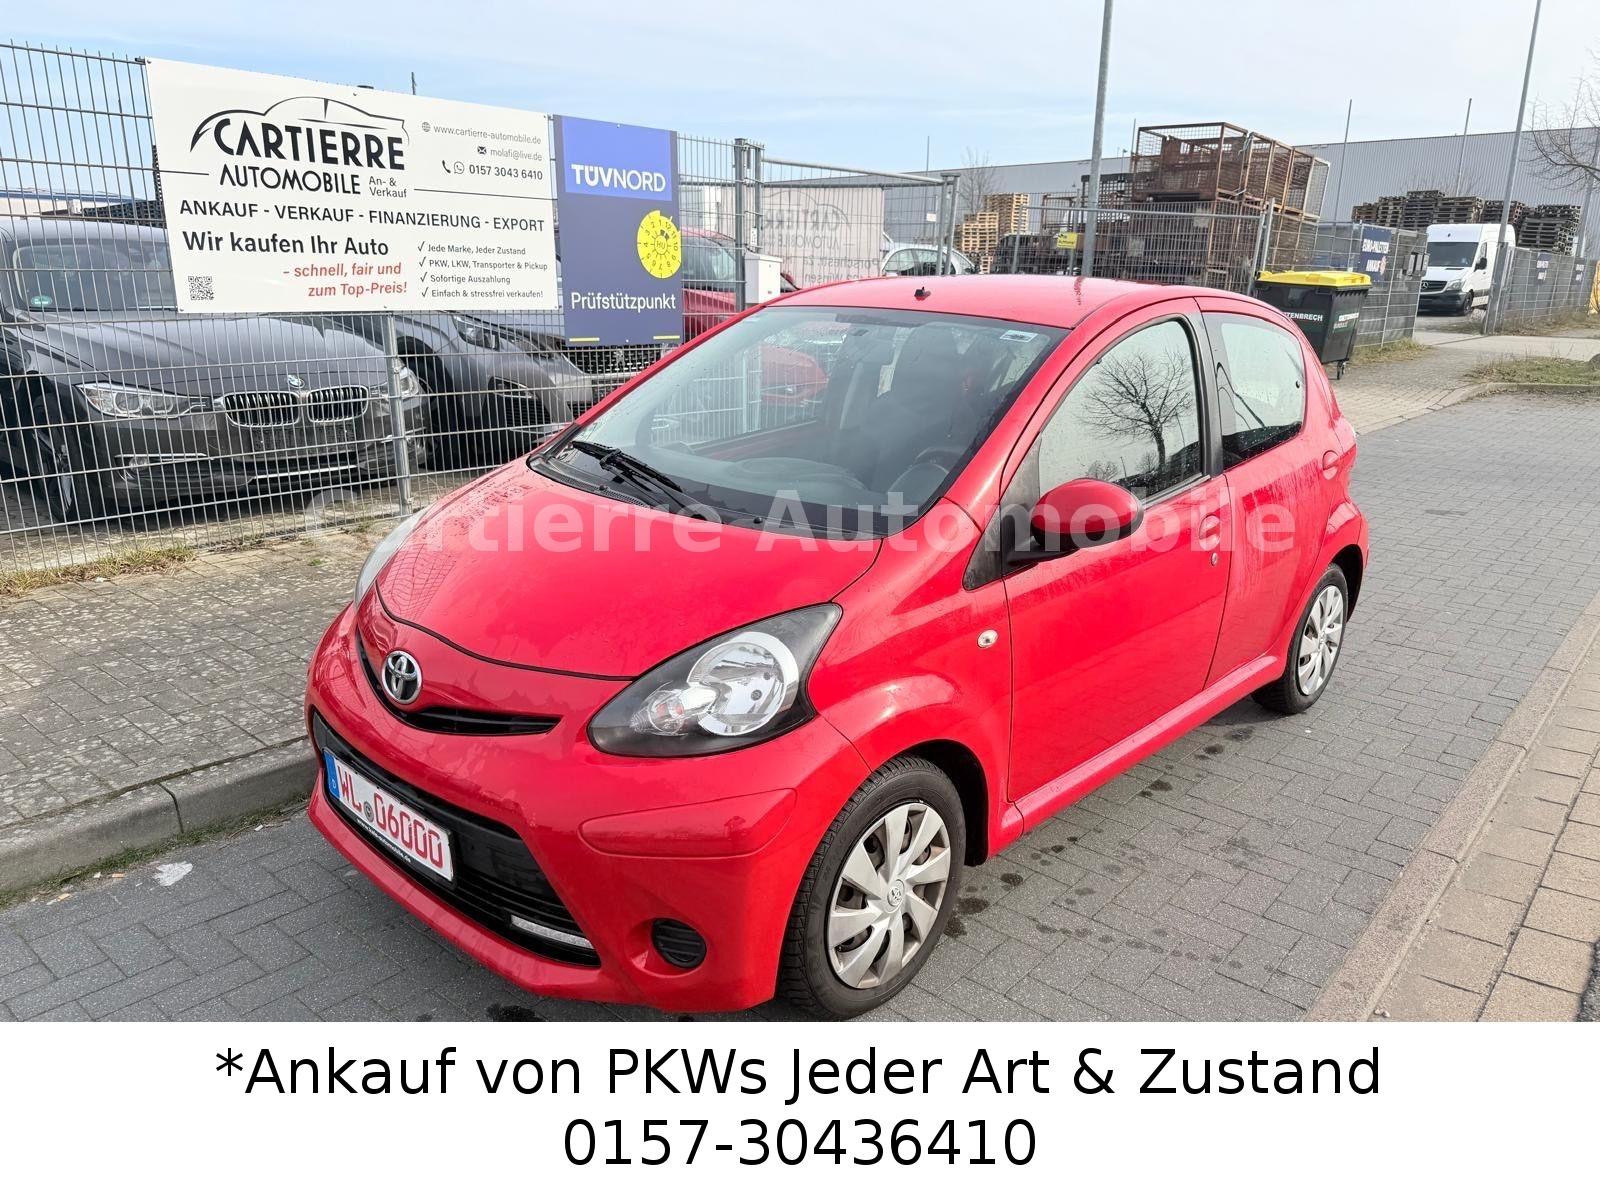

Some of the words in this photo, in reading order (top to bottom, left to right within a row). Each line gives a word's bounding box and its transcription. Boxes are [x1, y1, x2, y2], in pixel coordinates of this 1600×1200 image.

[433, 124, 541, 145] www.cartierre-automobile.de
[213, 118, 405, 170] CARTIERRE
[490, 147, 542, 161] molafi@live.de
[219, 163, 361, 195] AUTOMOBILE
[469, 164, 492, 176] 0157
[494, 166, 519, 178] 3043
[521, 168, 543, 180] 6410
[368, 175, 387, 186] An-
[389, 177, 397, 187] &
[369, 186, 407, 198] Verkauf
[180, 200, 259, 218] ANKAUF
[275, 205, 355, 223] VERKAUF
[368, 210, 481, 229] FINANZIERUNG
[493, 217, 545, 232] EXPORT
[182, 230, 223, 251] Wir
[230, 231, 304, 254] kaufen
[311, 234, 338, 254] Ihr
[344, 237, 389, 256] Auto
[427, 243, 446, 253] Jede
[447, 245, 474, 254] Marke,
[475, 246, 496, 254] Jeder
[497, 247, 526, 255] Zustand
[294, 263, 348, 278] schnell,
[351, 262, 374, 276] fair
[377, 262, 402, 275] und
[429, 259, 450, 268] PKW,
[451, 260, 471, 269] LKW,
[472, 260, 515, 270] Transporter
[524, 262, 548, 271] Pickup
[430, 274, 466, 284] Sofortige
[467, 275, 511, 285] Auszahlung
[308, 285, 336, 297] zum
[340, 282, 408, 299] Top-Preis!
[431, 289, 461, 298] Einfach
[462, 290, 468, 298] &
[470, 289, 505, 298] stressfrei
[506, 290, 544, 298] verkaufen!
[571, 291, 676, 314] Prüfstützpunkt
[337, 764, 362, 813] WL
[374, 792, 443, 869] 06000
